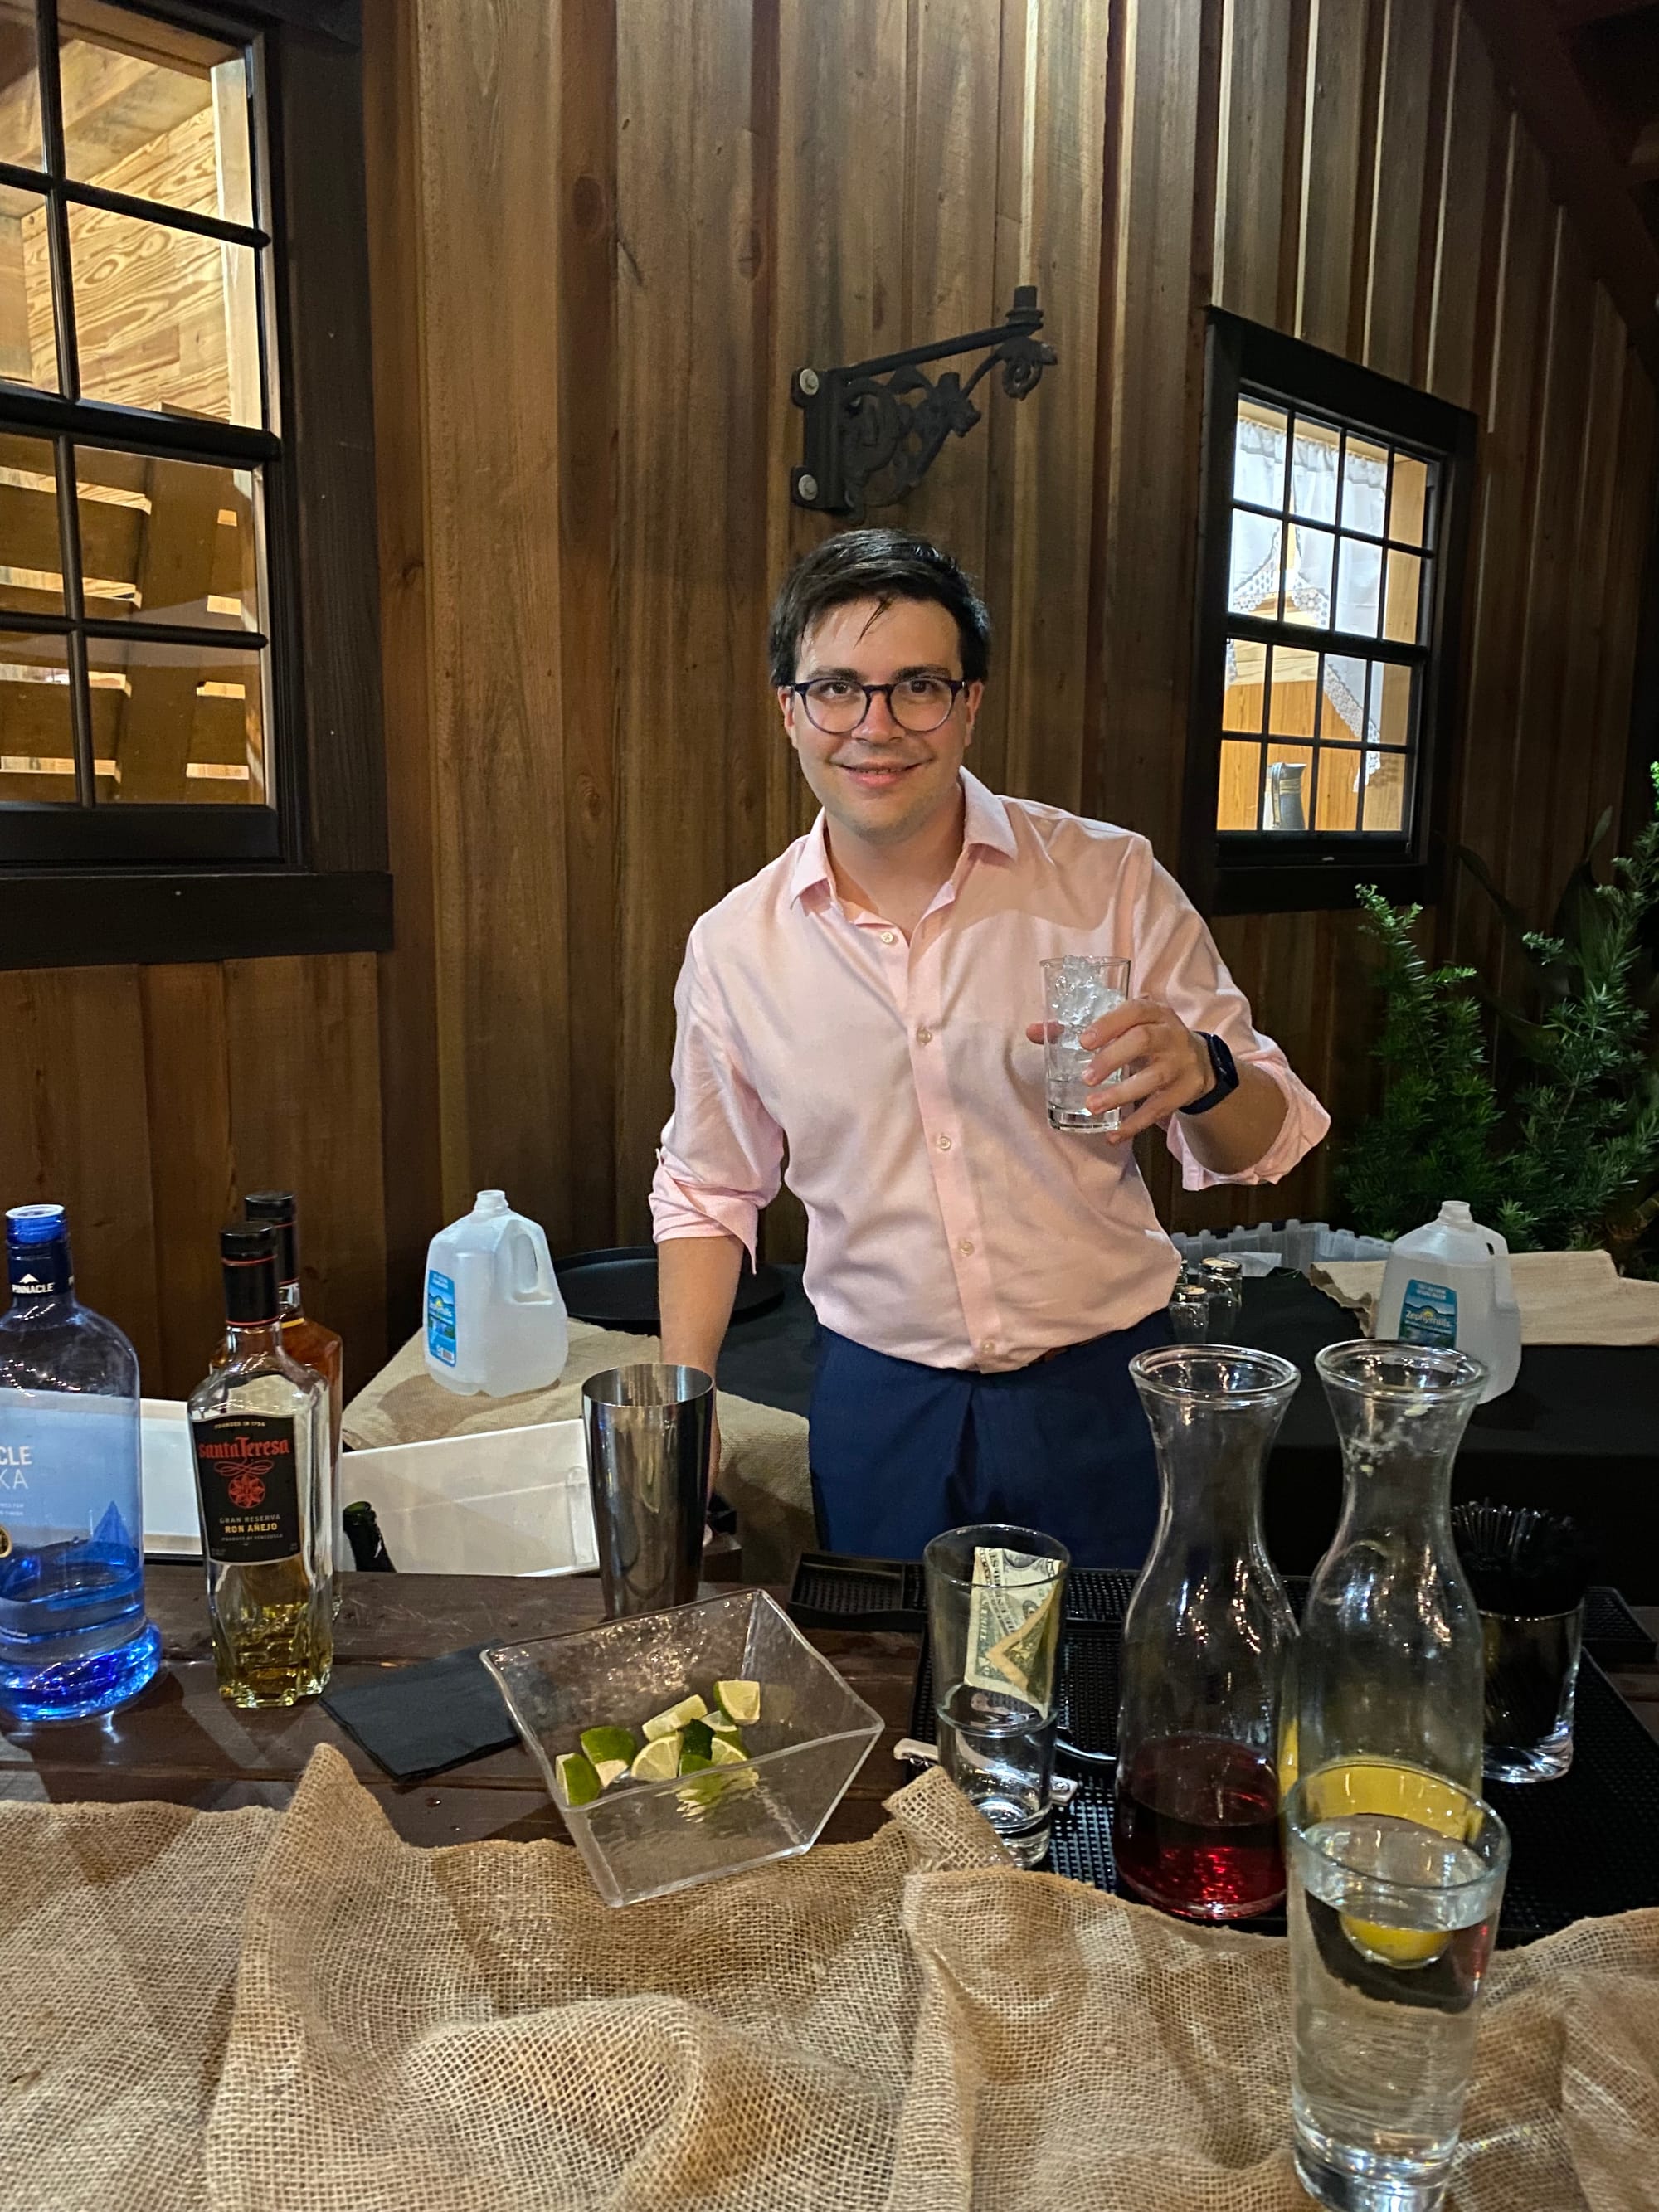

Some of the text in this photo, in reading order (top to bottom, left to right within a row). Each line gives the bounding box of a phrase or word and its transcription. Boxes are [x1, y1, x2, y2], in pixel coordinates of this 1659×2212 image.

[12, 1282, 55, 1294] PINNACLE
[219, 1514, 281, 1524] GRAN RESERVA
[225, 1522, 278, 1534] RON AÑEJO
